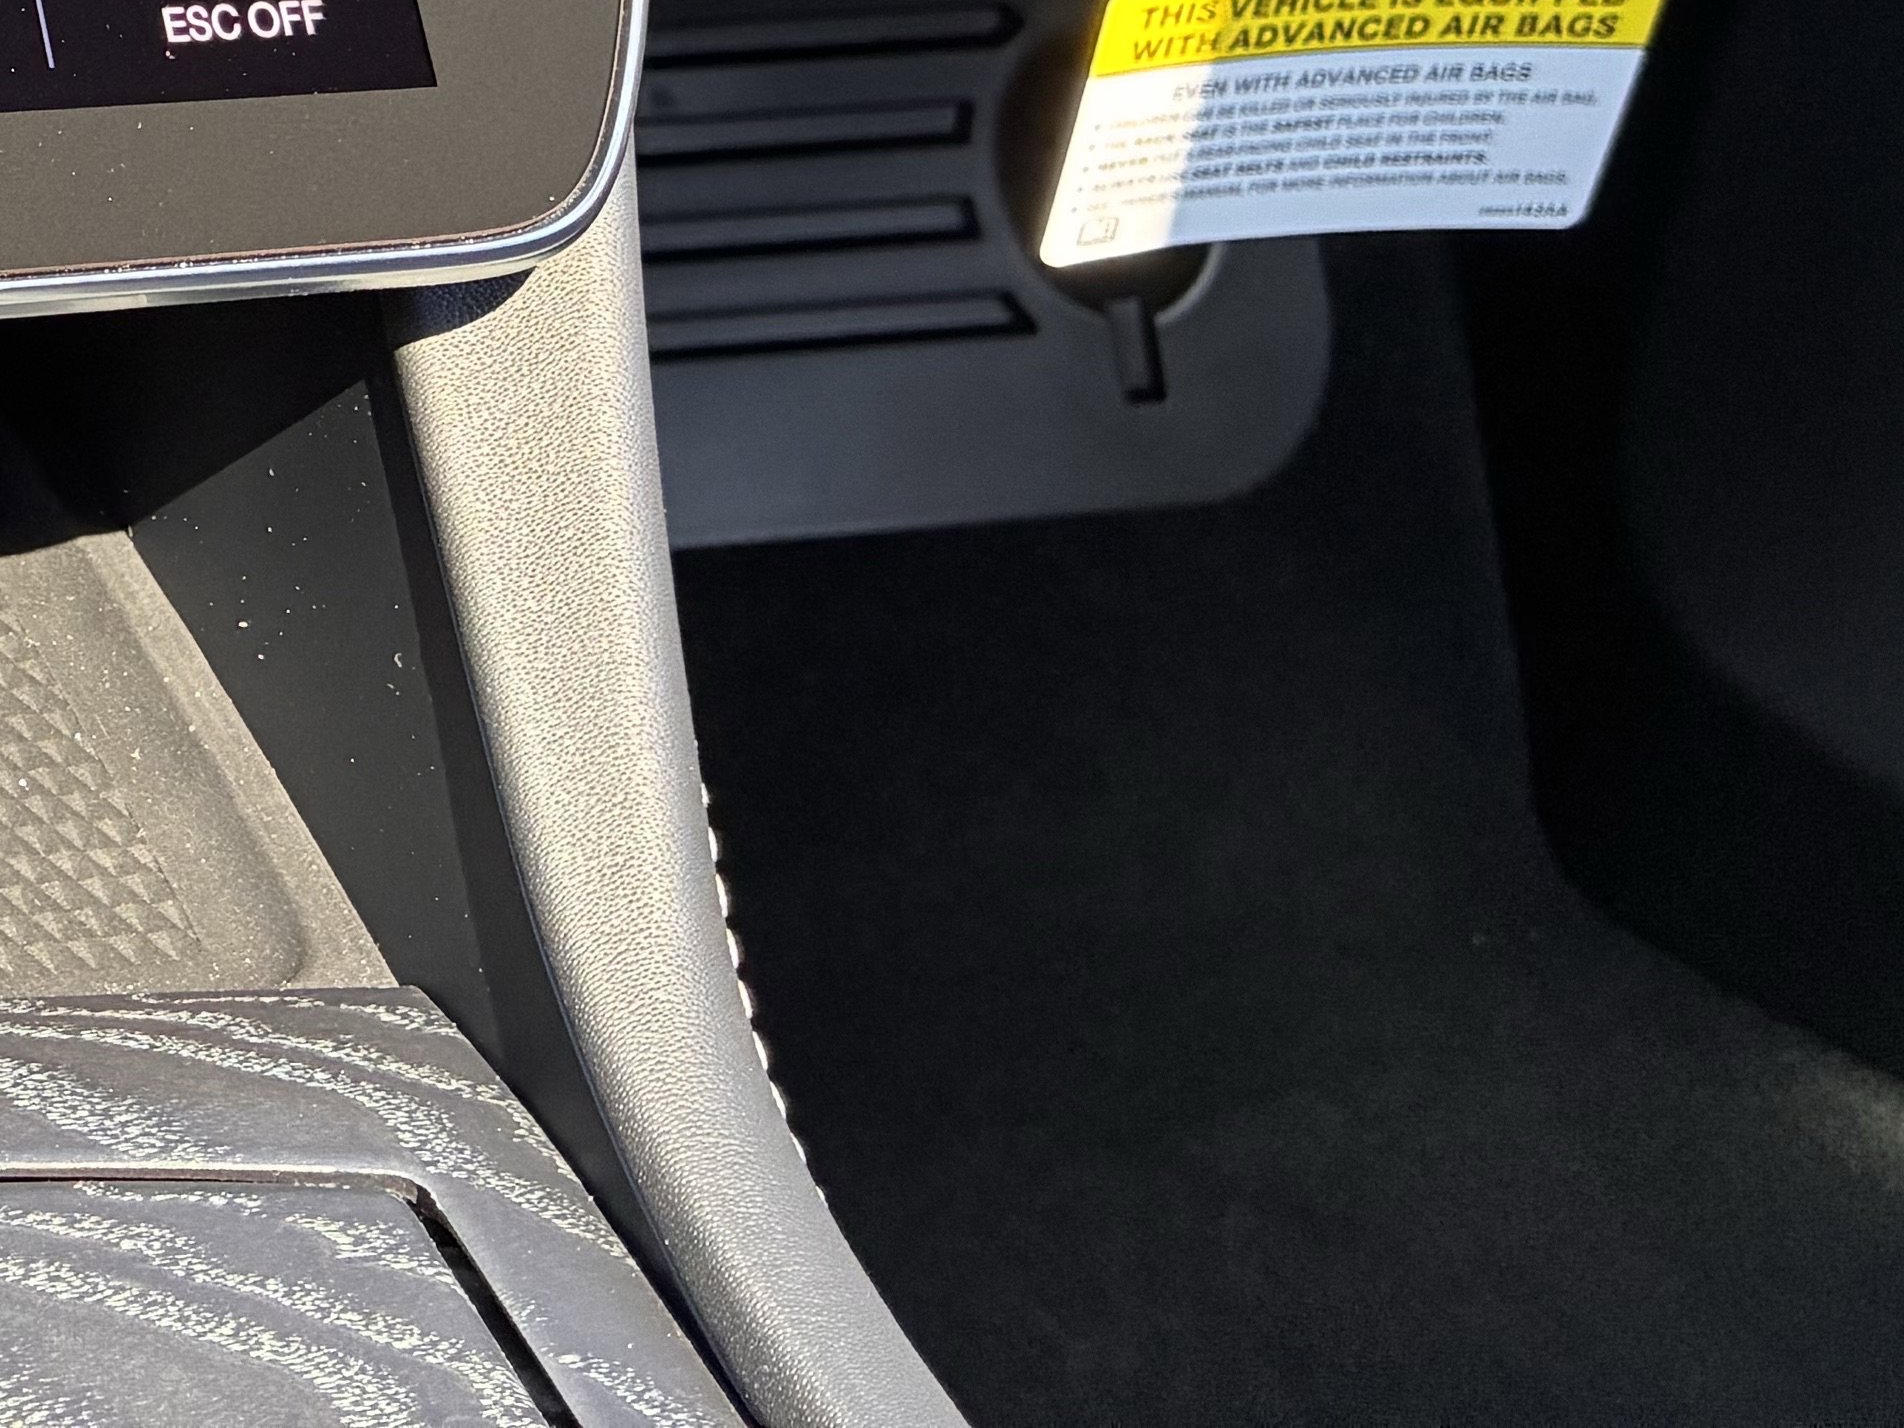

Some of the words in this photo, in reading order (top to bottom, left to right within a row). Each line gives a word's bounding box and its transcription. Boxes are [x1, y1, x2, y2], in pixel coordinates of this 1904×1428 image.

[161, 2, 242, 43] ESC
[1142, 0, 1219, 30] THIS
[1132, 31, 1225, 62] WITH
[1227, 12, 1431, 52] ADVANCED
[1439, 12, 1505, 39] AIR
[1514, 11, 1620, 39] BAGS
[1234, 72, 1290, 95] WITH
[1295, 63, 1421, 87] ADVANCED
[1424, 62, 1464, 83] AIR
[1469, 61, 1533, 82] BAGS
